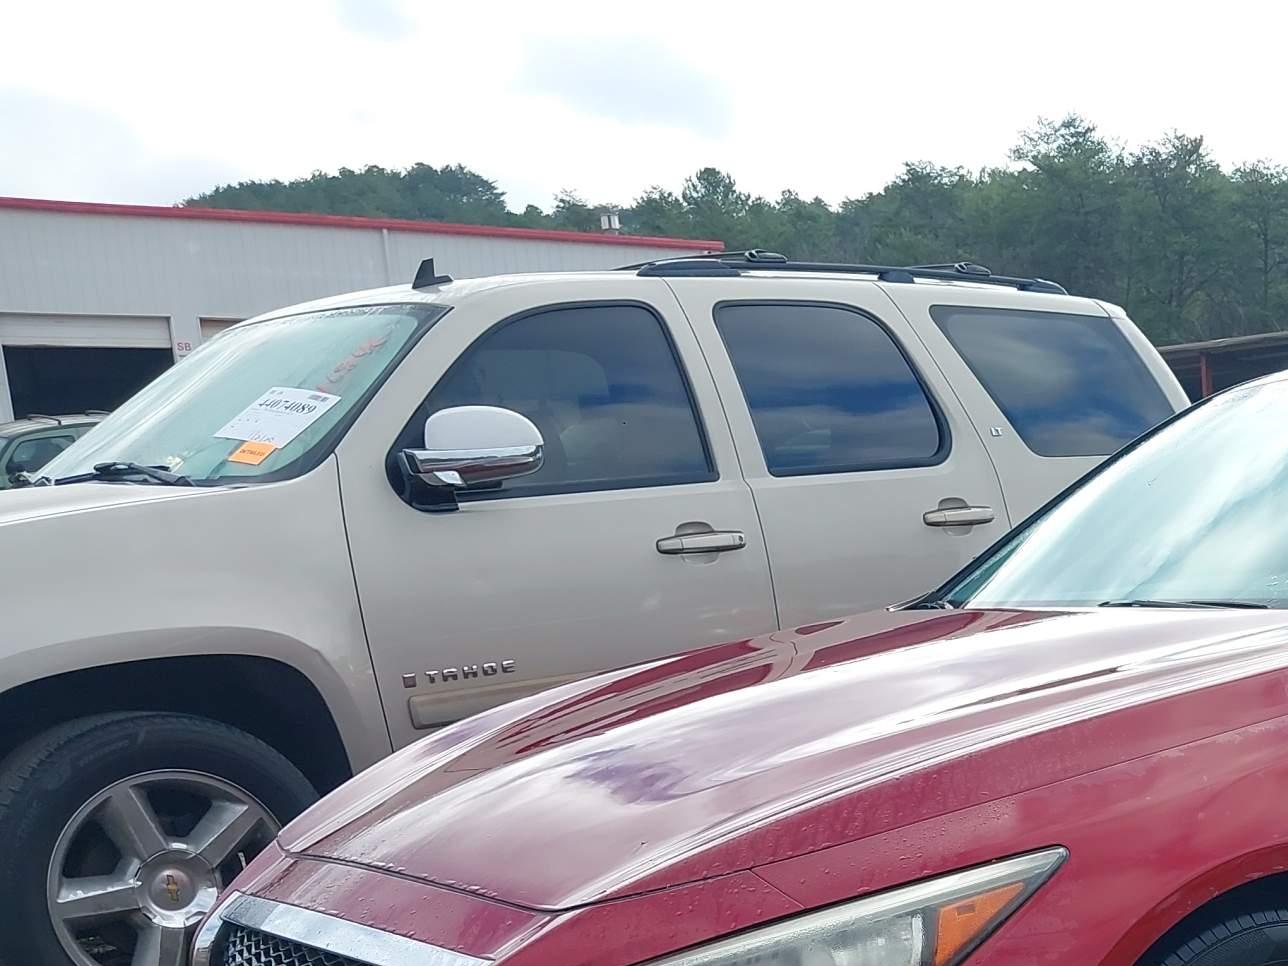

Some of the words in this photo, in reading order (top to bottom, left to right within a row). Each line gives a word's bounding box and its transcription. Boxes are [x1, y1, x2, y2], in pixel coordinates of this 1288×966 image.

[258, 398, 318, 415] 44074089
[990, 426, 1003, 437] LT
[424, 659, 516, 684] TAHOE
